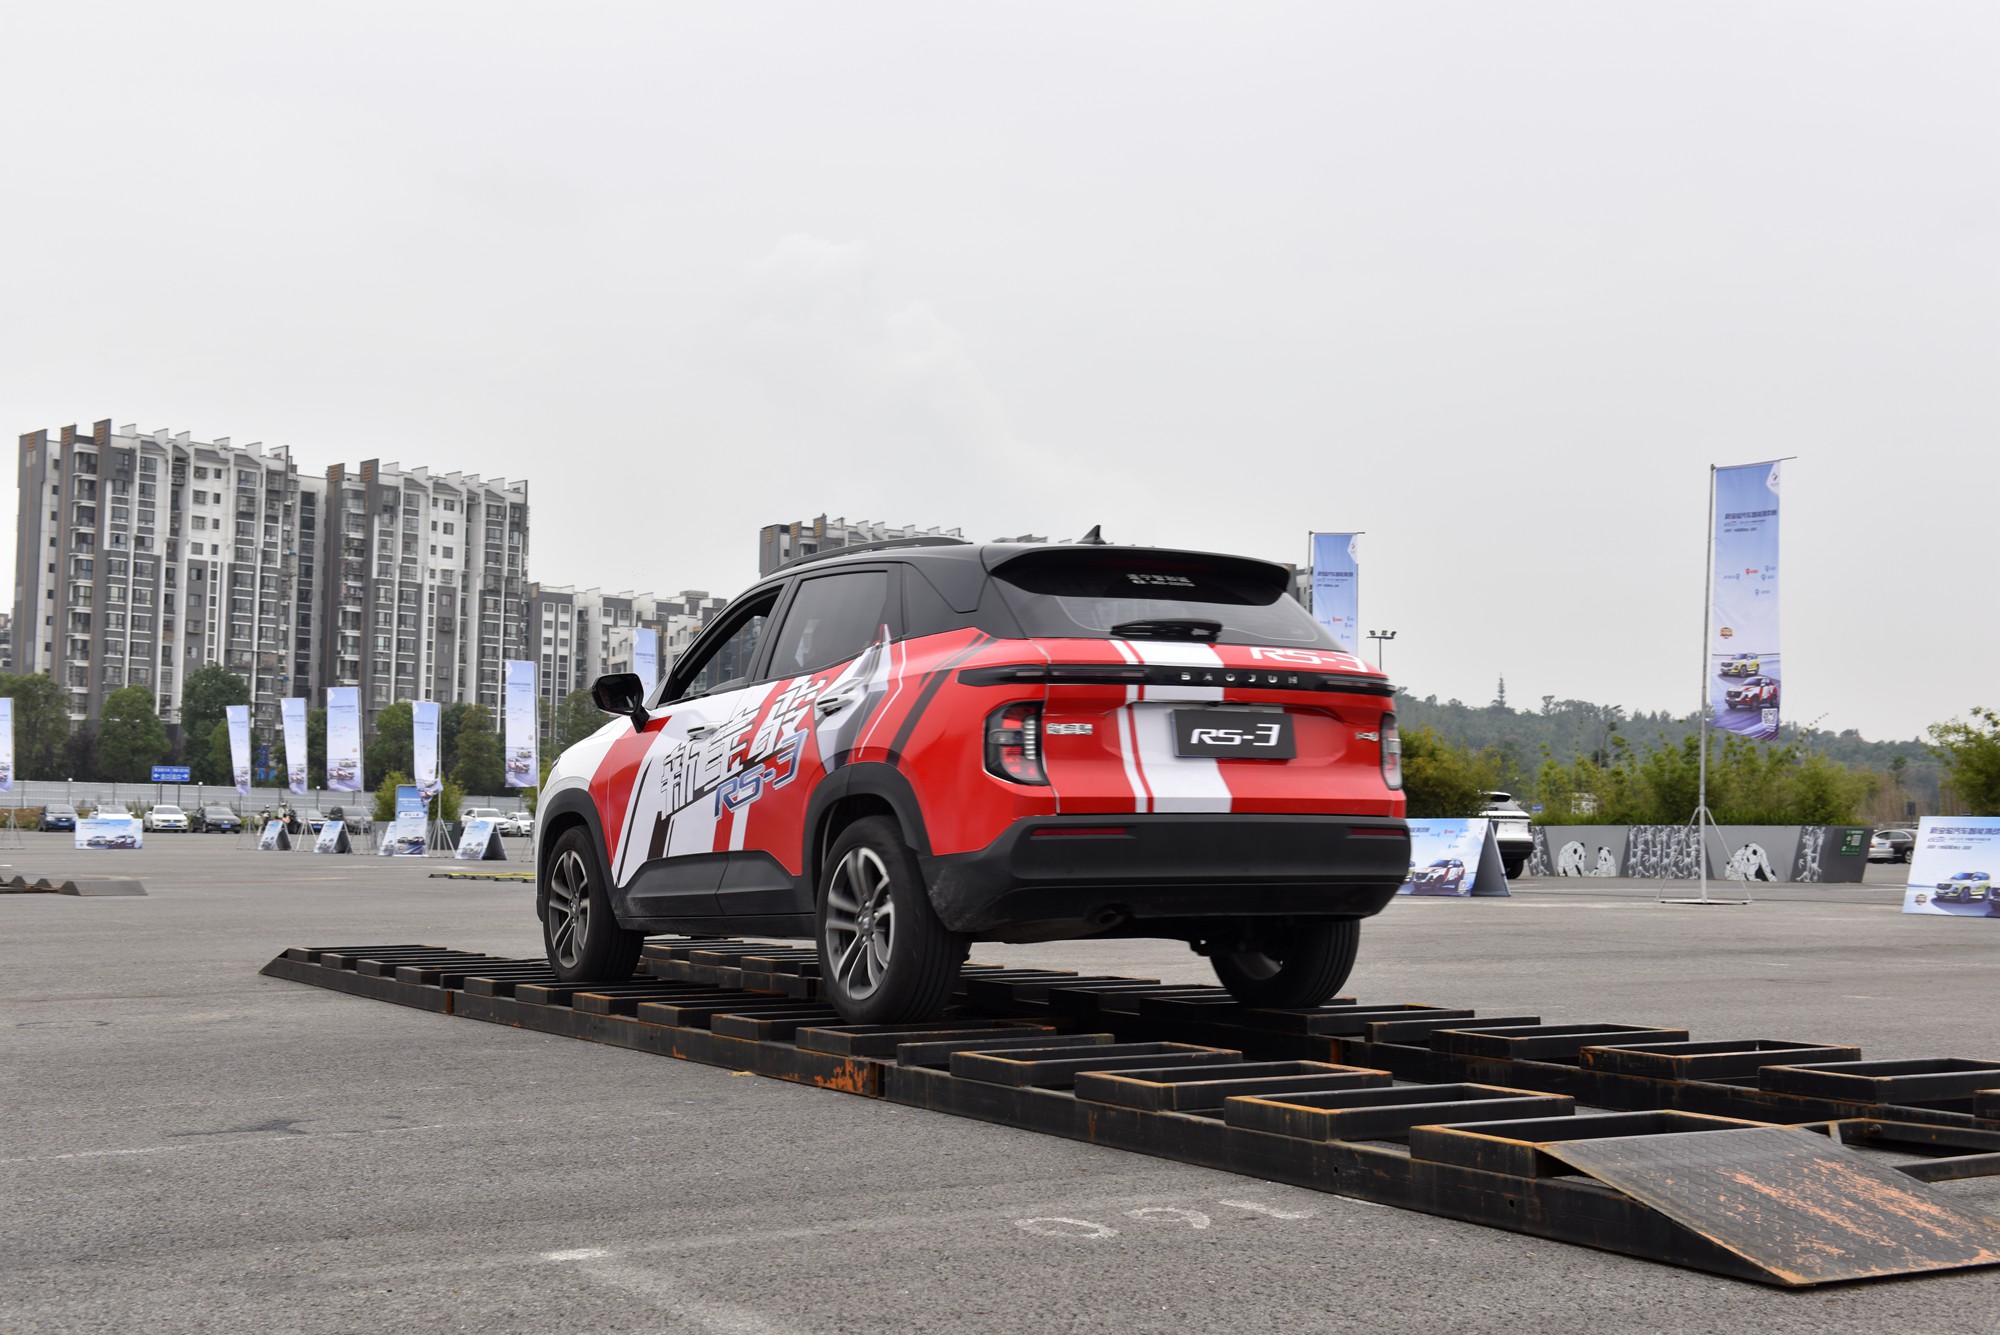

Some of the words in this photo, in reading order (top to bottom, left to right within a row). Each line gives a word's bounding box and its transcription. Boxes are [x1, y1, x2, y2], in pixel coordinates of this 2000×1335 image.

[1250, 647, 1368, 673] RS-3
[1181, 672, 1298, 684] BAOJUN
[1190, 723, 1281, 746] RS-3
[661, 677, 828, 820] 新宝骏
[713, 727, 809, 820] RS-3
